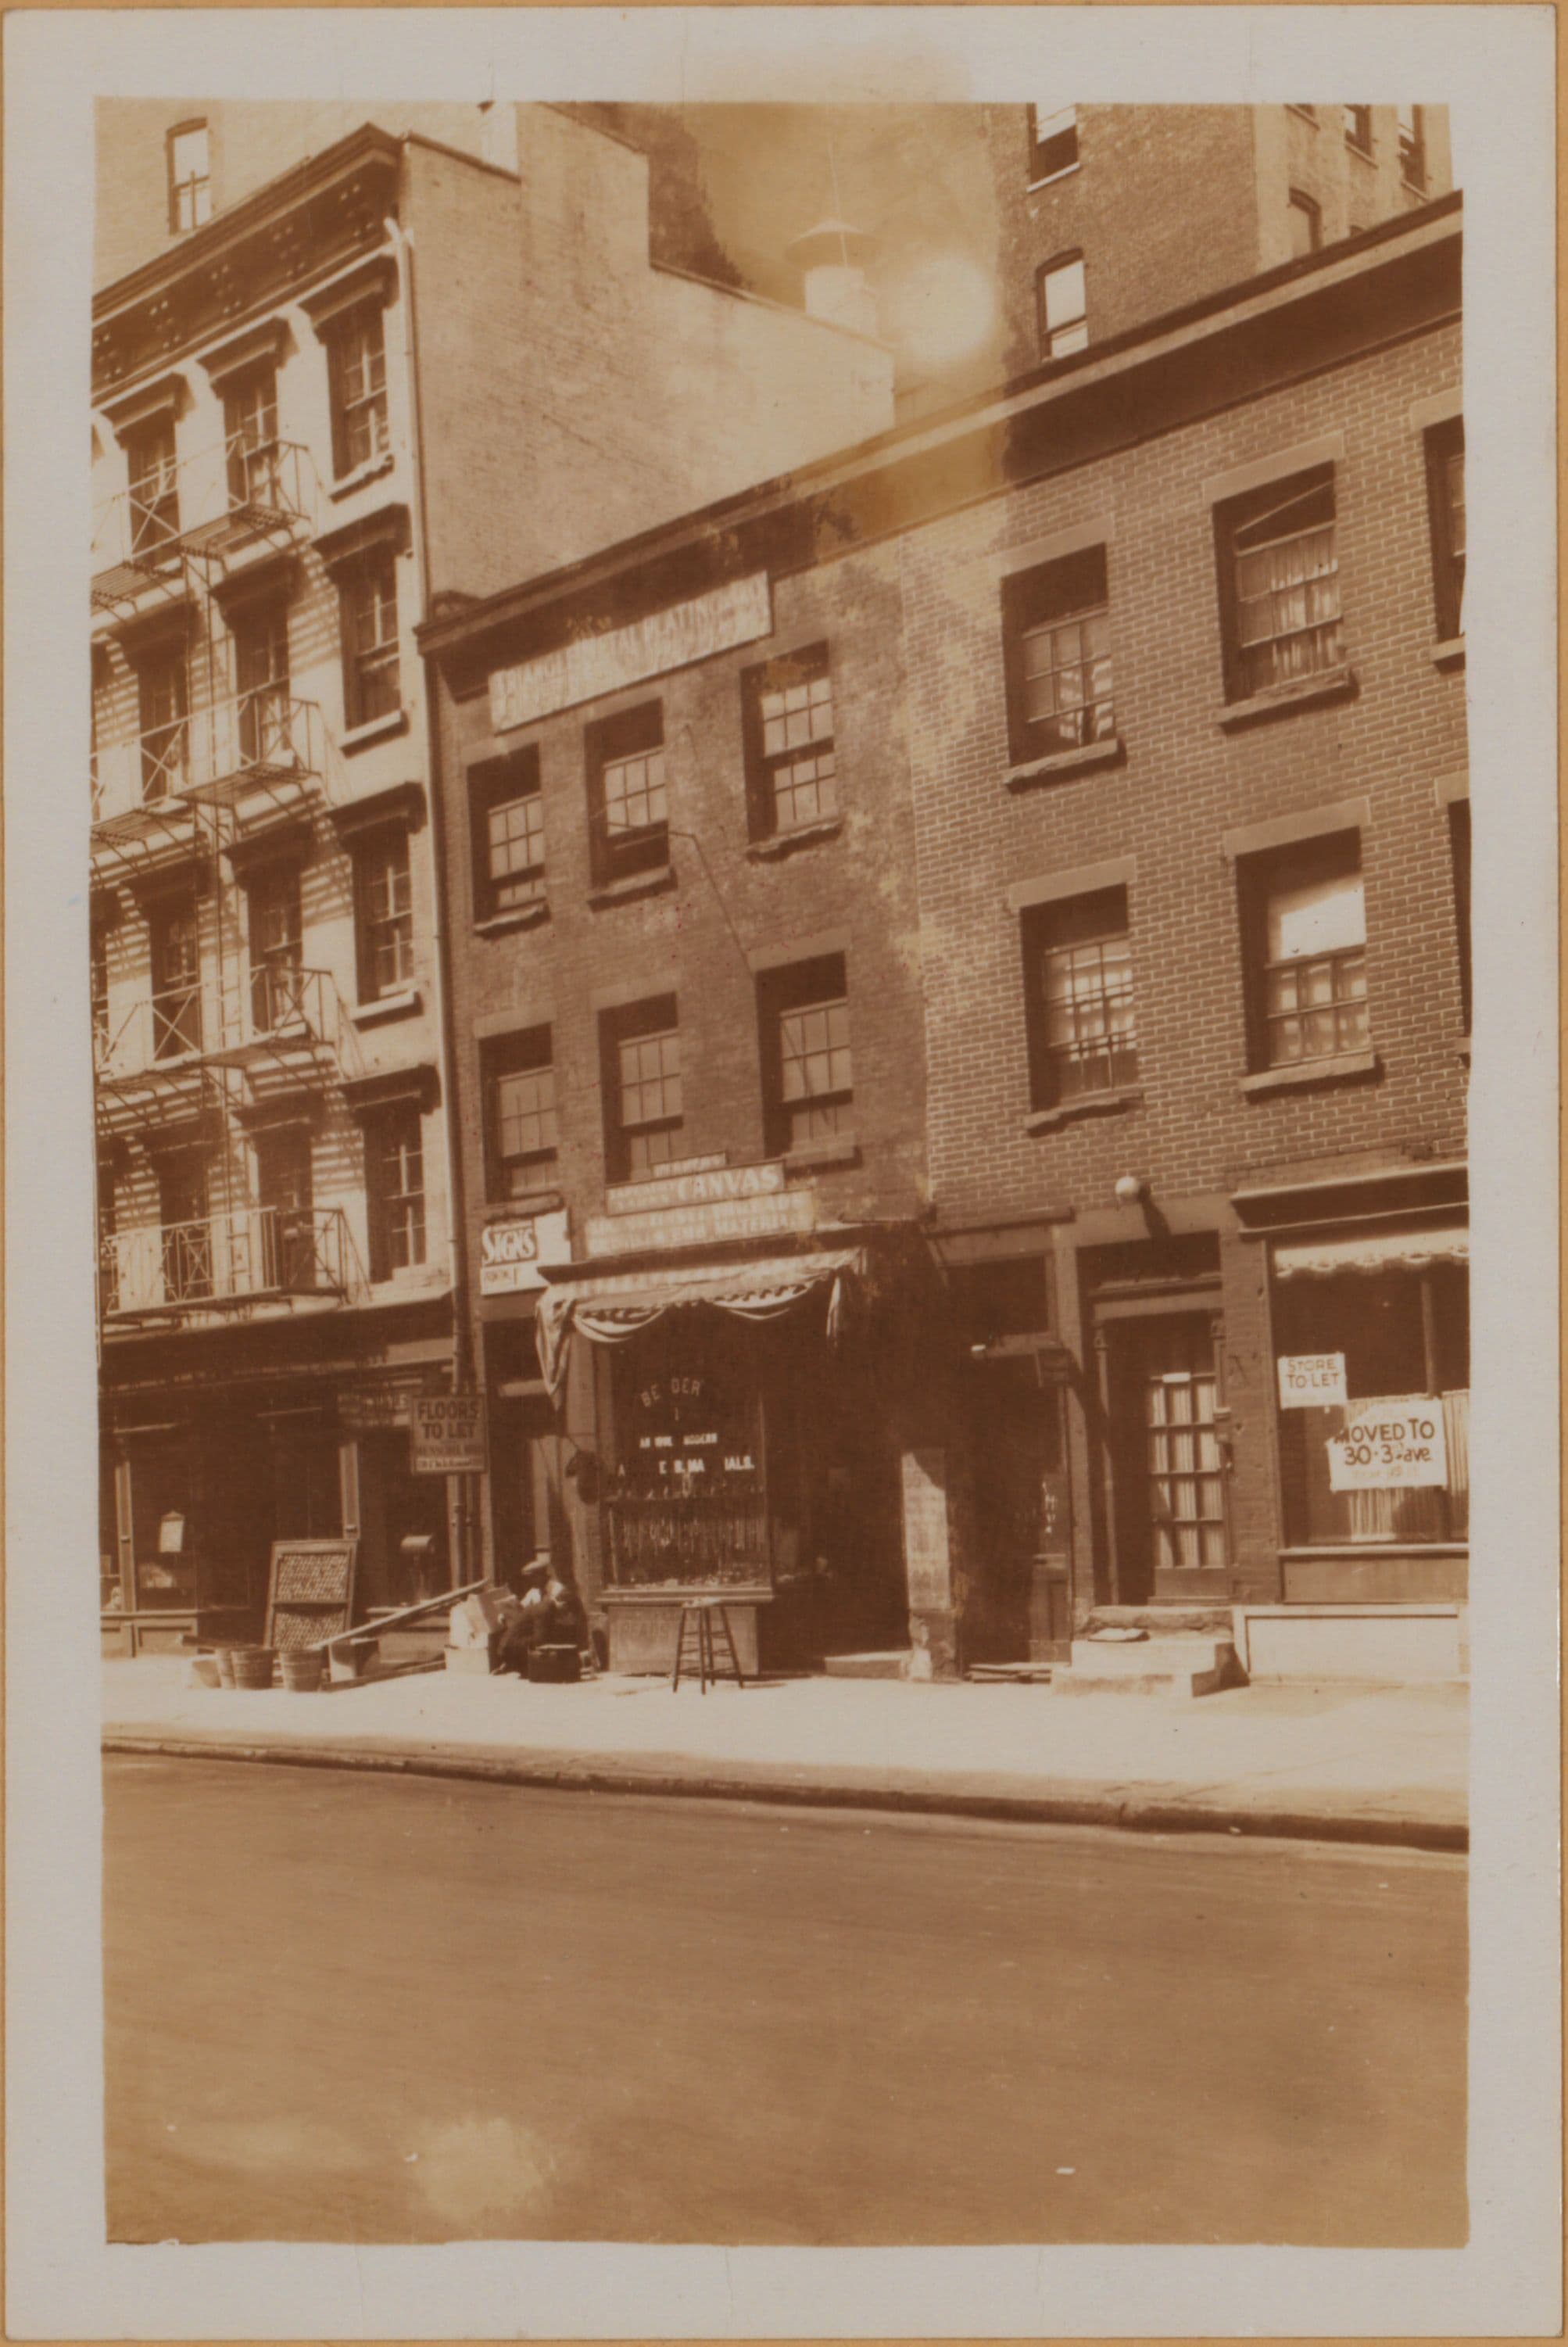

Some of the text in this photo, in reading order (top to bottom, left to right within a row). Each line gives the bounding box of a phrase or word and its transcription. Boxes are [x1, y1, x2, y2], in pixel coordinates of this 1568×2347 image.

[678, 1166, 779, 1201] CANVAS
[481, 1226, 535, 1264] SIGNS
[1288, 1359, 1336, 1373] STORE
[1286, 1372, 1338, 1388] TO LET
[418, 1400, 478, 1420] FLOORS
[422, 1422, 475, 1439] TO LET
[1408, 1418, 1435, 1439] TO
